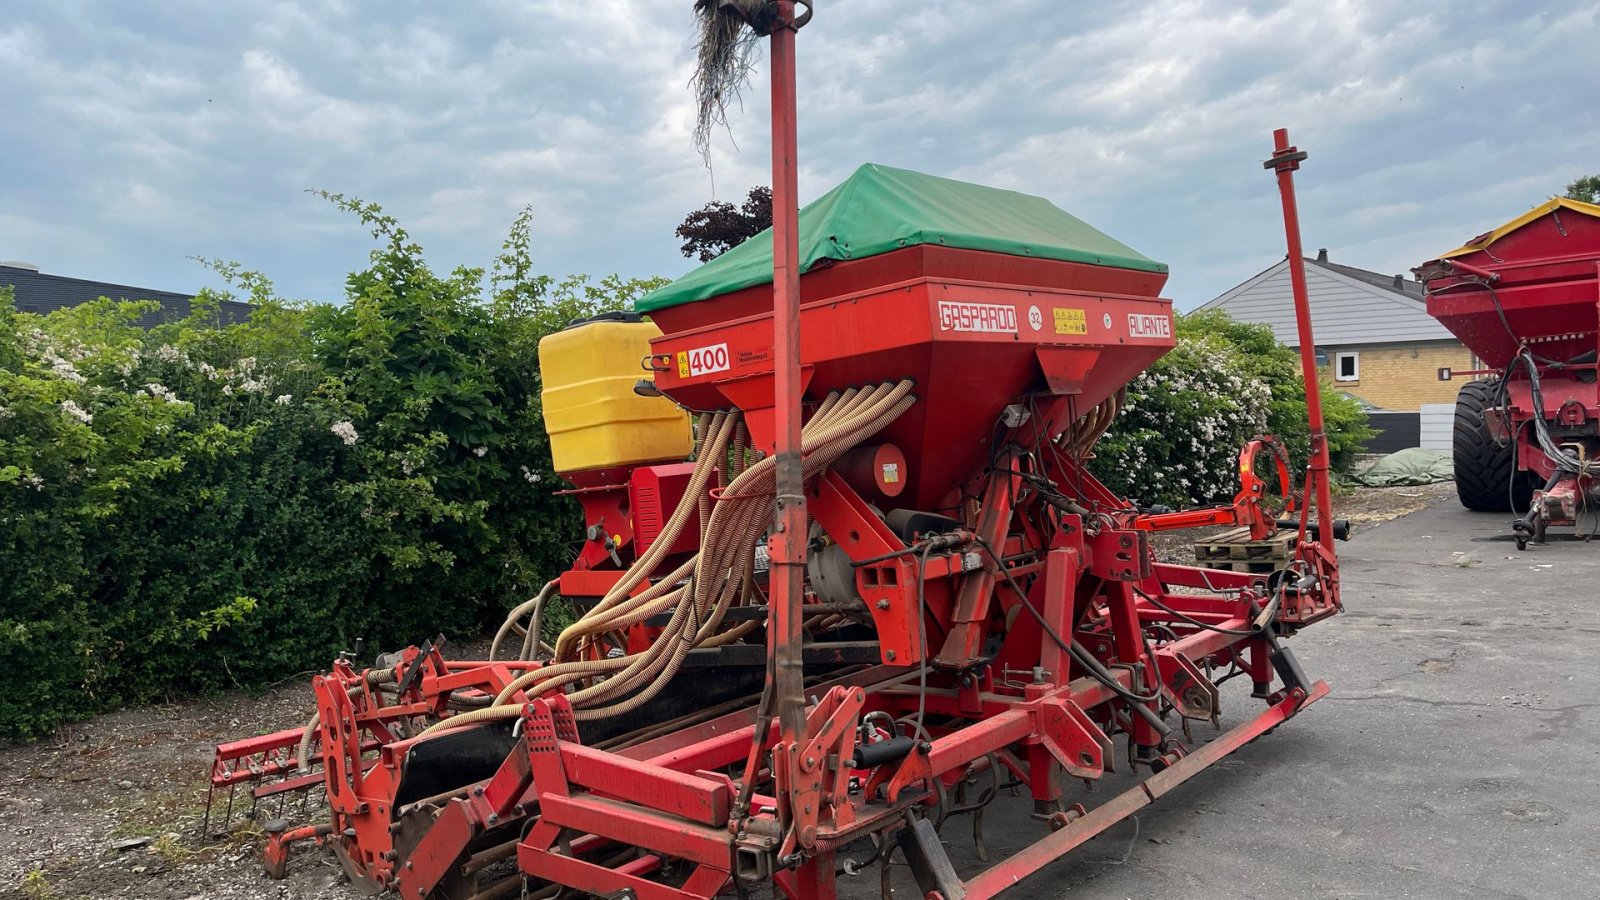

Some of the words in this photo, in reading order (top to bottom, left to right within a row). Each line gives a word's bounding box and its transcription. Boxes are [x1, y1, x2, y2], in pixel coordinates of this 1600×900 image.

[940, 304, 1016, 330] GASPARDO
[1030, 312, 1041, 325] 32
[1129, 316, 1169, 335] ALIANTE
[692, 347, 727, 372] 400
